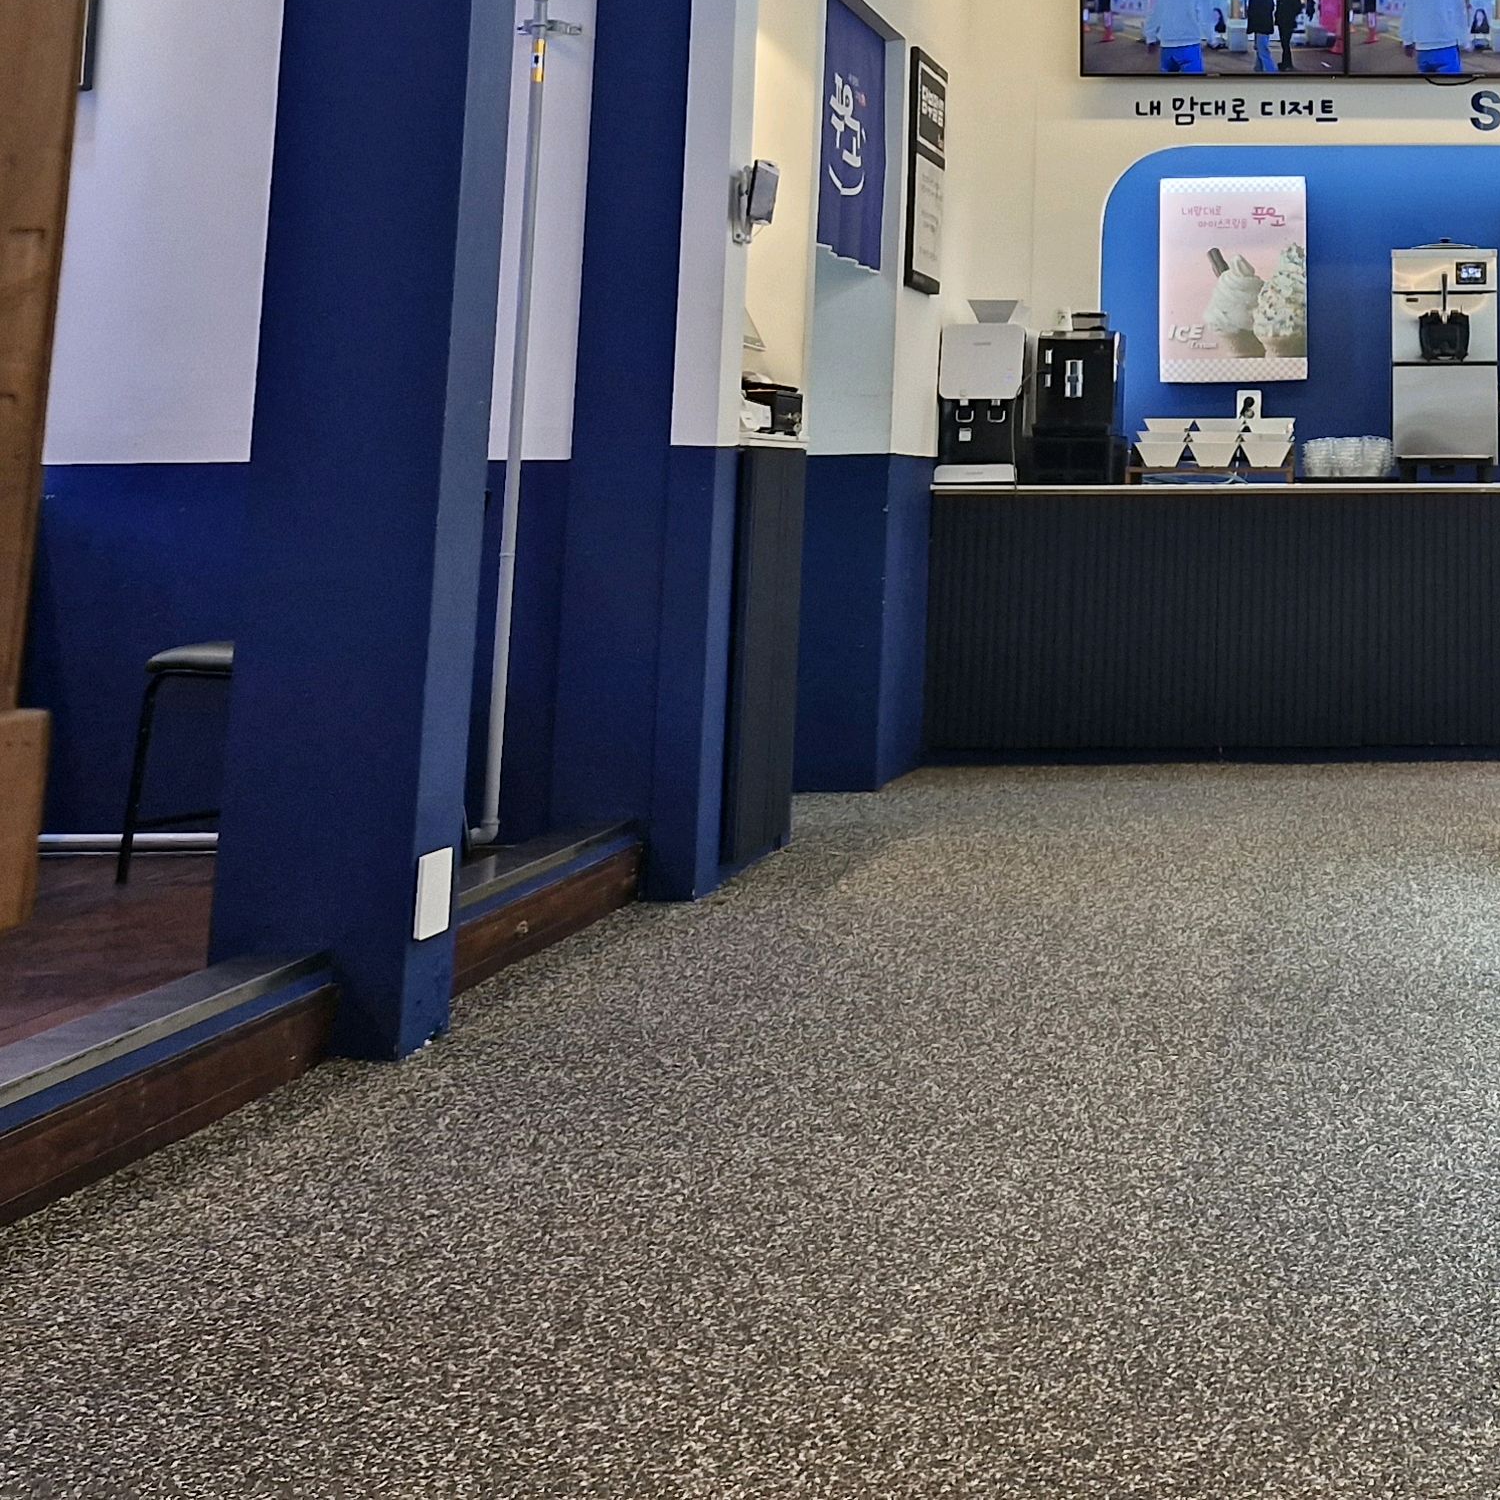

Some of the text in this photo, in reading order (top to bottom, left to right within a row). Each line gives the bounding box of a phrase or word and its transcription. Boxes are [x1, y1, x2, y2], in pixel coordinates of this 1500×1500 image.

[1135, 96, 1338, 126] 내 맘대로 디저트
[1168, 324, 1205, 343] ICE
